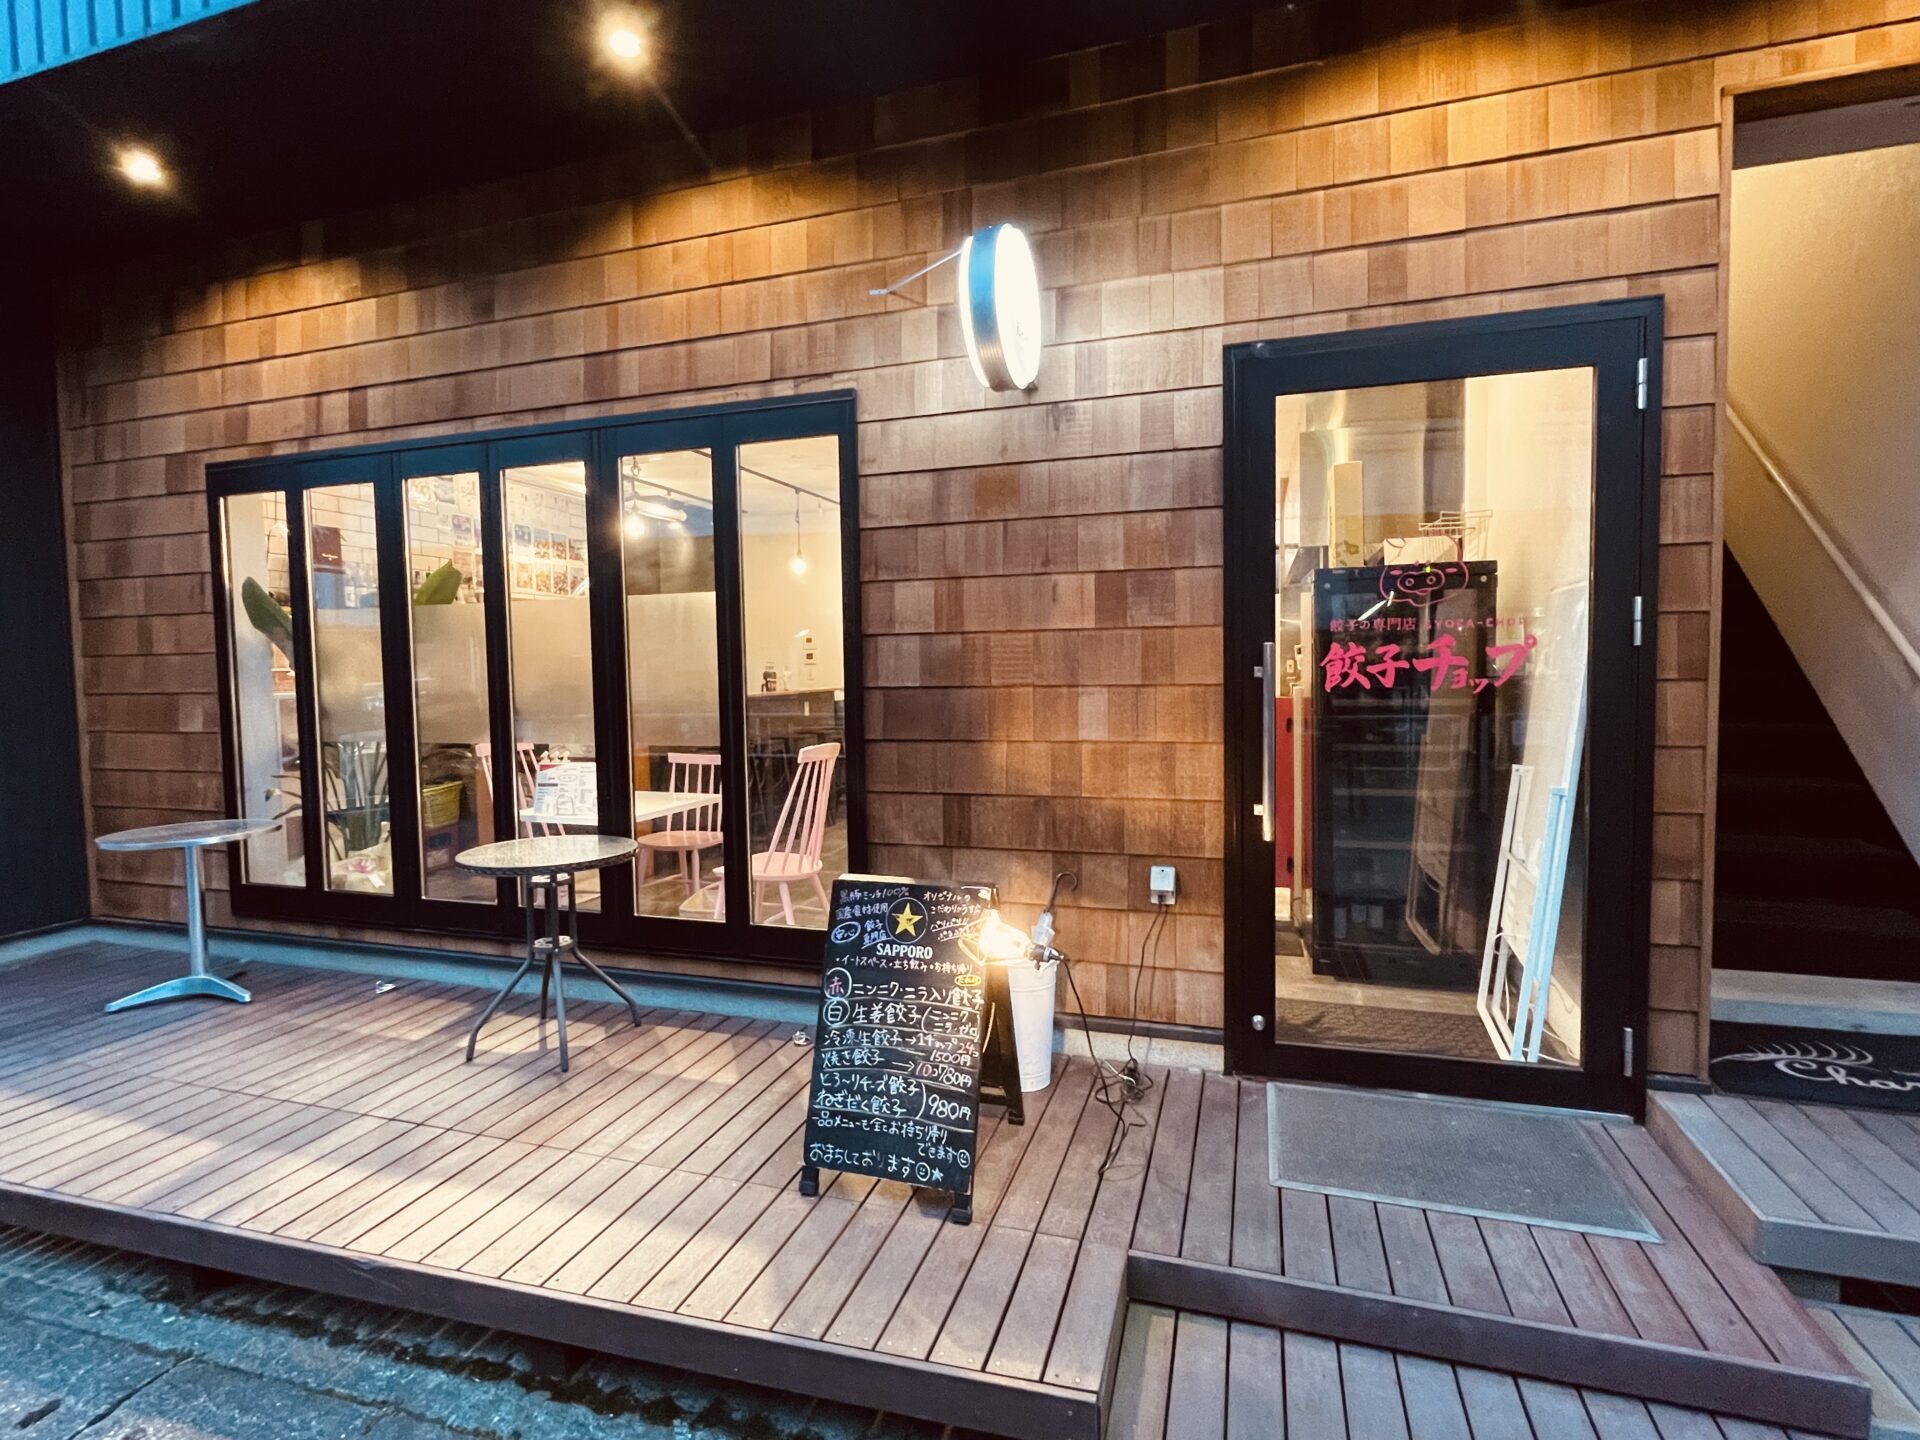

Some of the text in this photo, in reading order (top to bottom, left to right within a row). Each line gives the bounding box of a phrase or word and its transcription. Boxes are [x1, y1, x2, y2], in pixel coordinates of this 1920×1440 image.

[1329, 617, 1417, 632] 餃子の専門店
[1320, 633, 1538, 693] 餃子チョップ
[923, 890, 971, 902] オリジナルの
[876, 942, 933, 960] SAPPORO
[827, 976, 845, 995] 赤
[828, 1001, 922, 1025] 白 生姜餃子
[822, 1047, 885, 1069] 焼き餃子
[817, 1089, 972, 1121] ねぎだく餃子 980円
[809, 1143, 916, 1178] おまちしております
